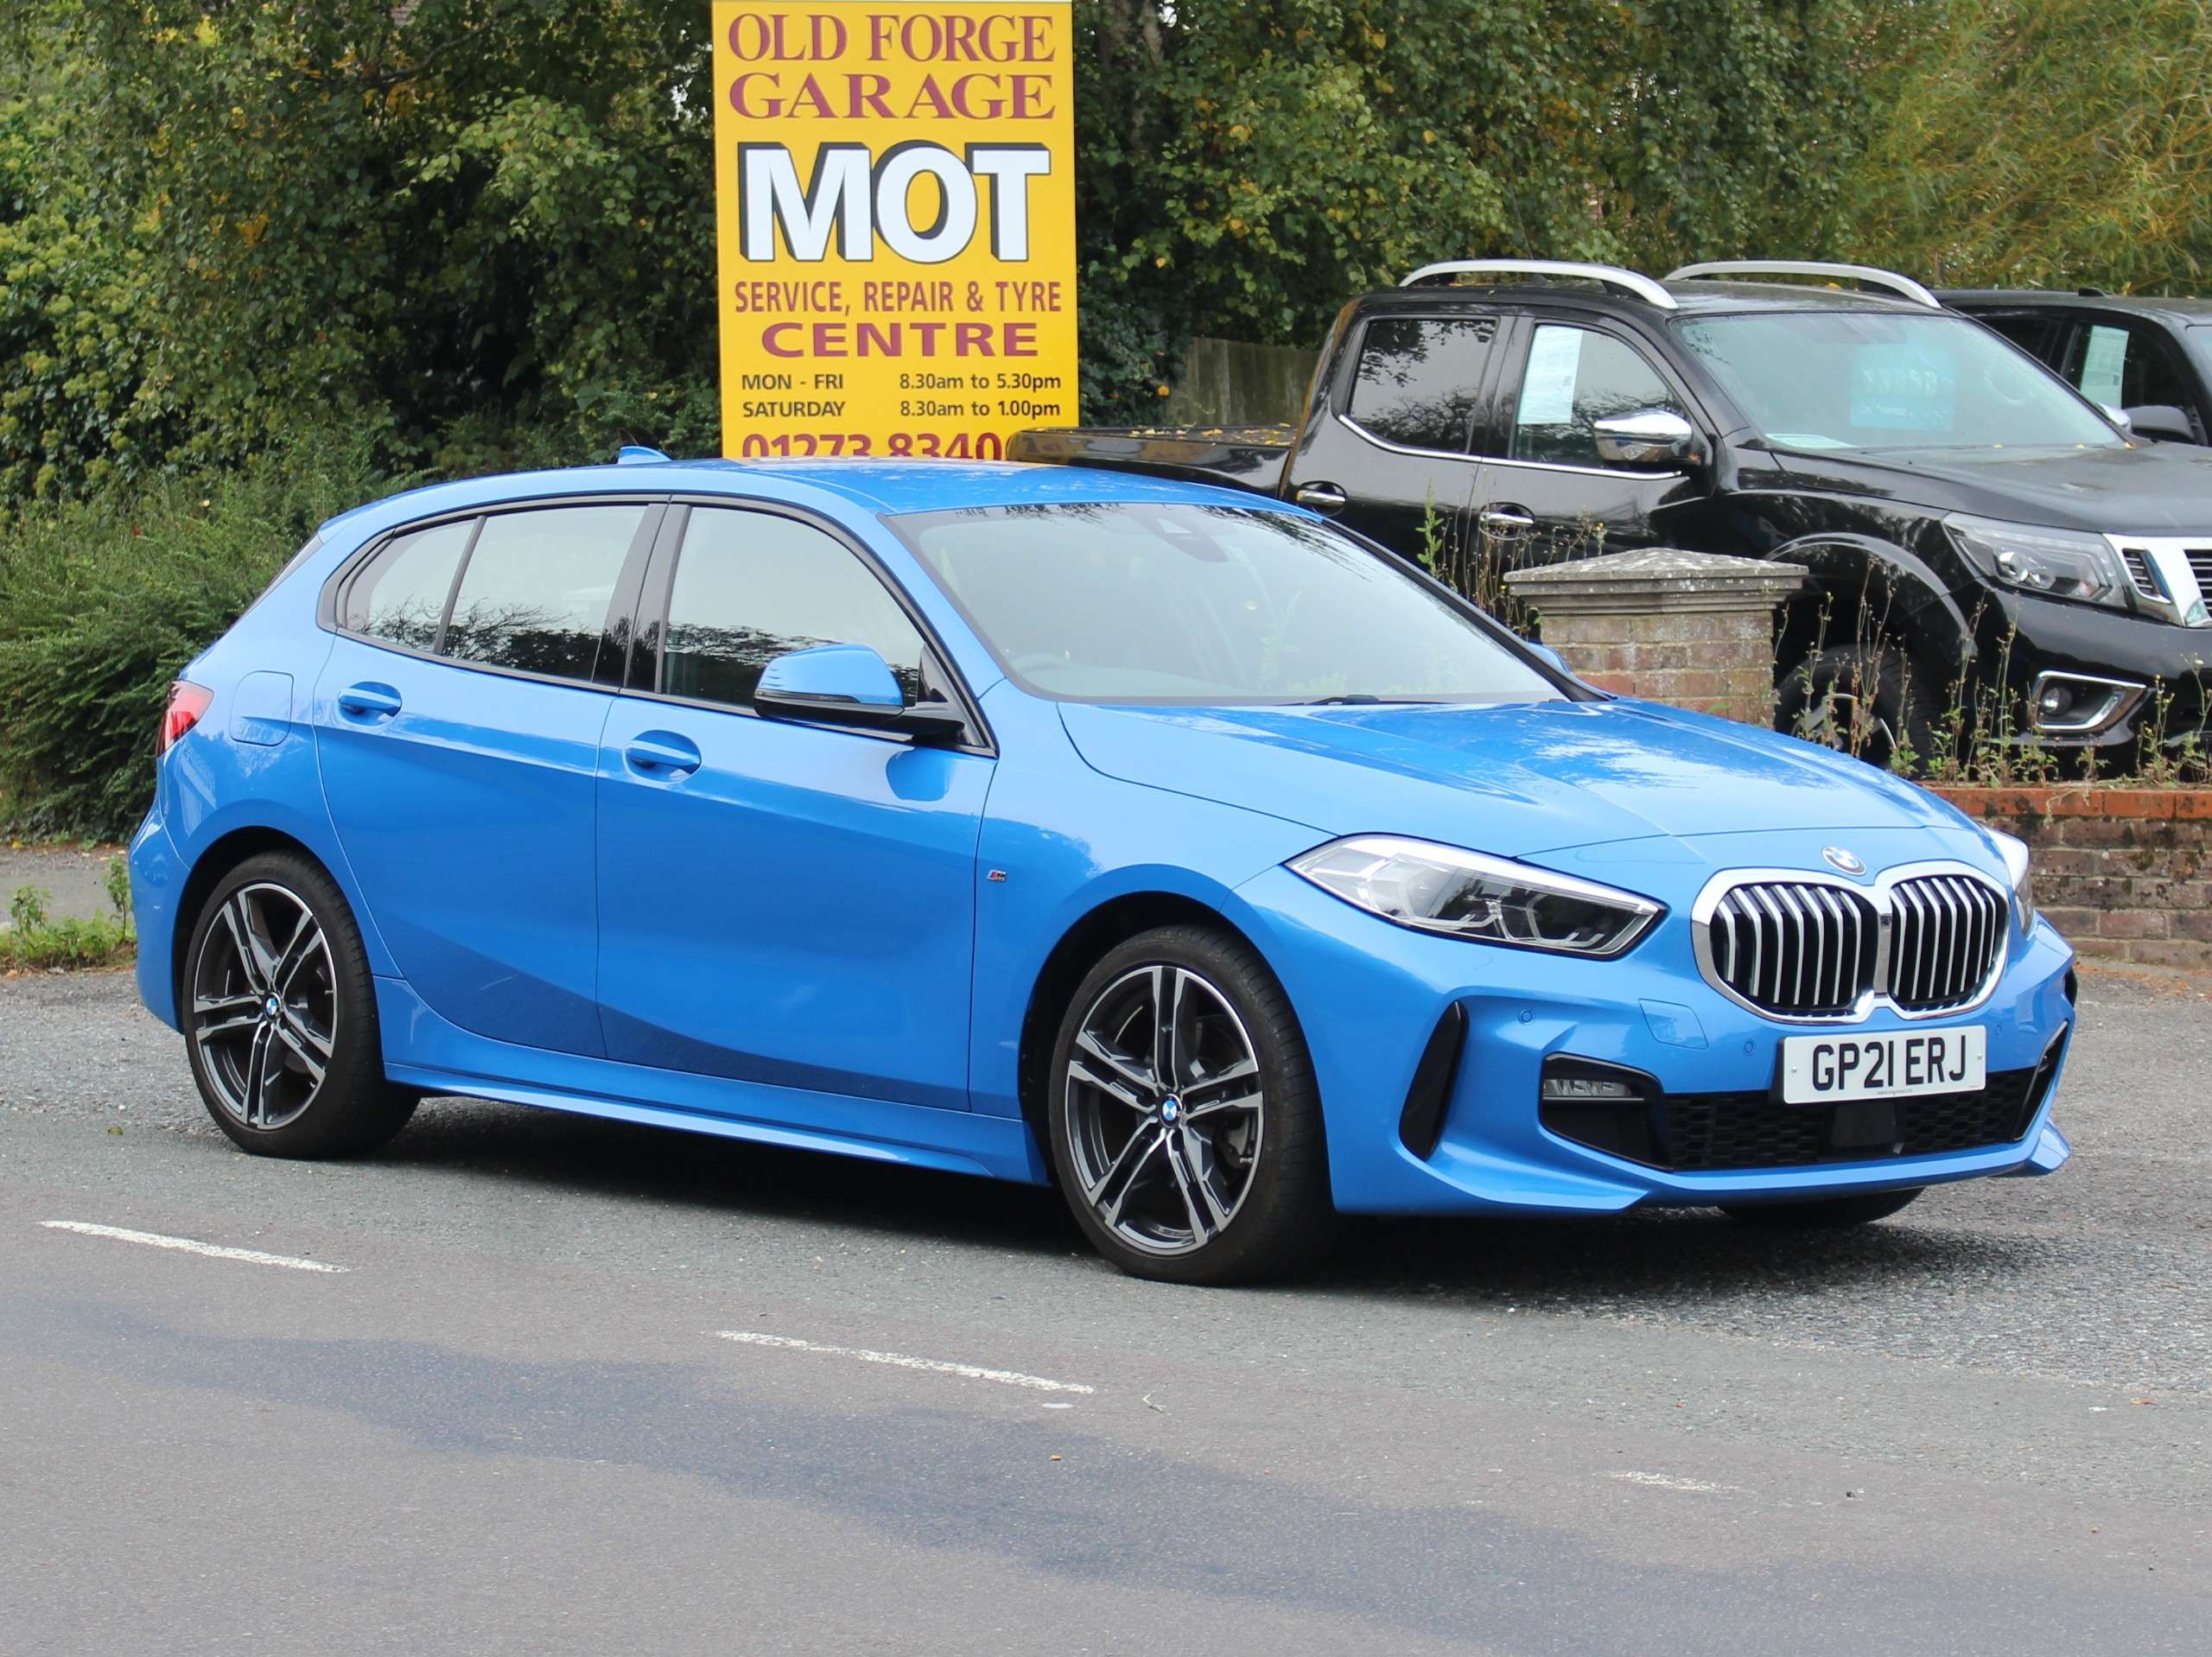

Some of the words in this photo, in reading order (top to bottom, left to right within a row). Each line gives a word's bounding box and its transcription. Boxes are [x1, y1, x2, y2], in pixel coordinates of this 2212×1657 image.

[728, 13, 848, 61] OLD
[867, 14, 1056, 61] FORGE
[729, 72, 1056, 119] GARAGE
[737, 139, 1052, 263] MOT
[735, 281, 851, 316] SERVICE,
[865, 281, 954, 312] REPAIR
[967, 281, 984, 312] &
[995, 281, 1062, 312] TYRE
[762, 322, 1039, 358] CENTRE
[741, 374, 792, 390] MON
[814, 374, 843, 390] FRI
[899, 373, 964, 390] 8.30am
[970, 374, 990, 390] to
[997, 373, 1062, 393] 5.30pm
[742, 402, 846, 418] SATURDAY
[899, 400, 964, 416] 8.30am
[971, 402, 990, 416] to
[998, 400, 1061, 420] 1.00pm
[888, 432, 1013, 460] 8340
[1812, 1040, 1894, 1091] GP21
[1905, 1035, 1966, 1085] ERJ
